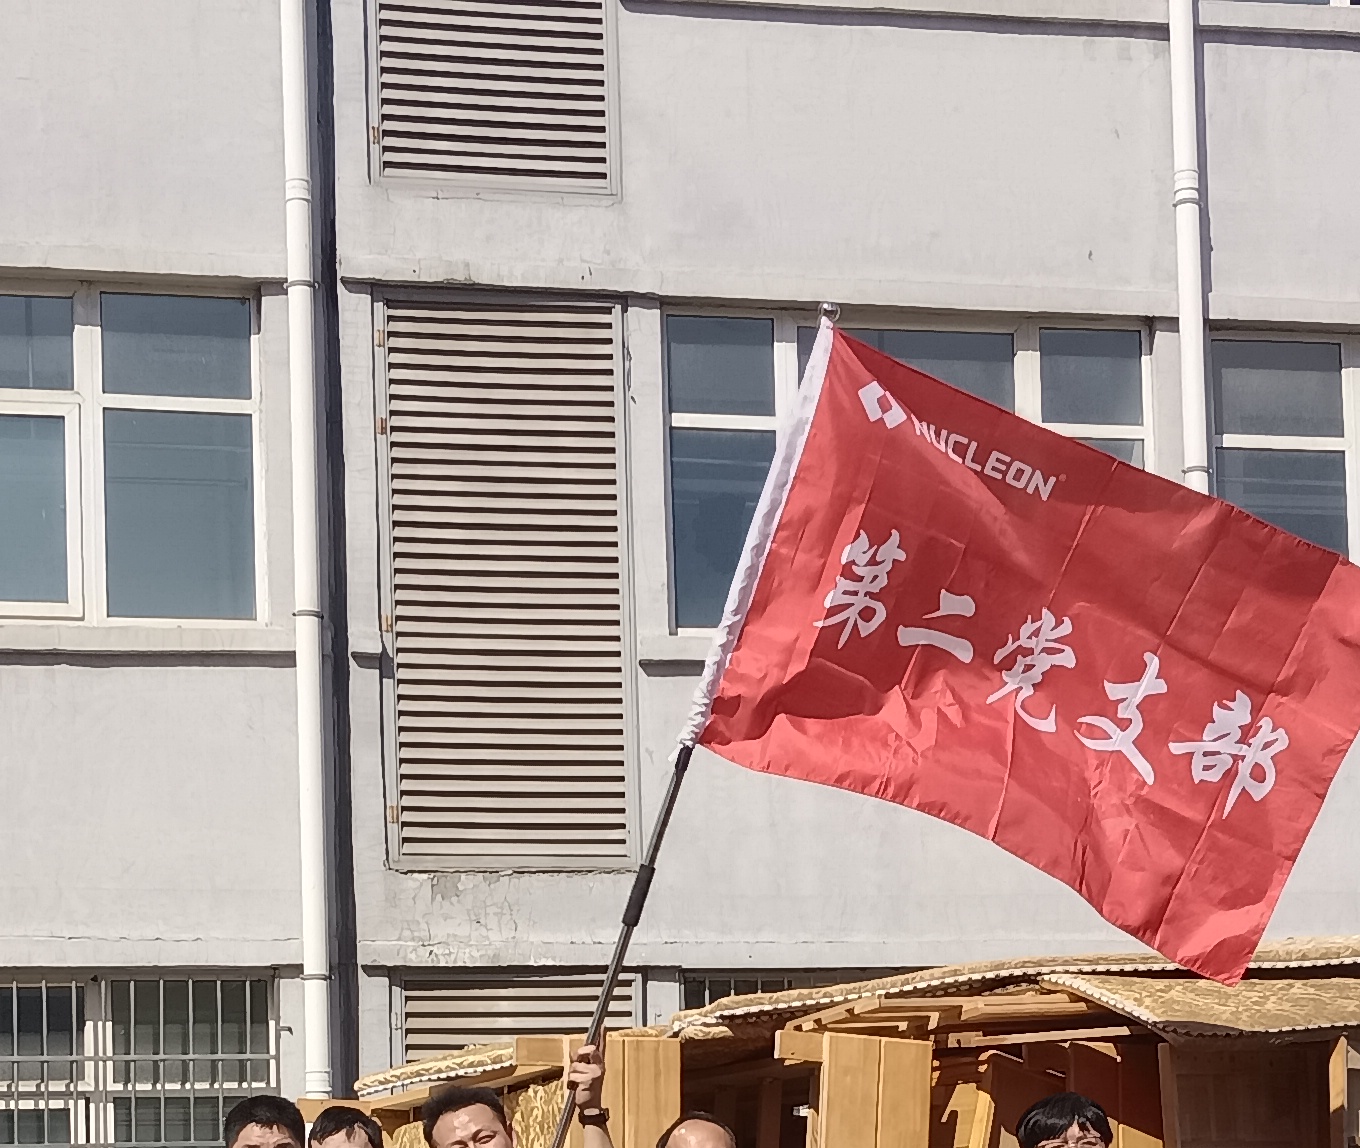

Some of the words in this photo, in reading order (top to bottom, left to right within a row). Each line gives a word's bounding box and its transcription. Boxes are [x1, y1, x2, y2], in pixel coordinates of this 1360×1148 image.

[911, 415, 1057, 501] NUCLEON
[814, 529, 1289, 819] 第二党支部
